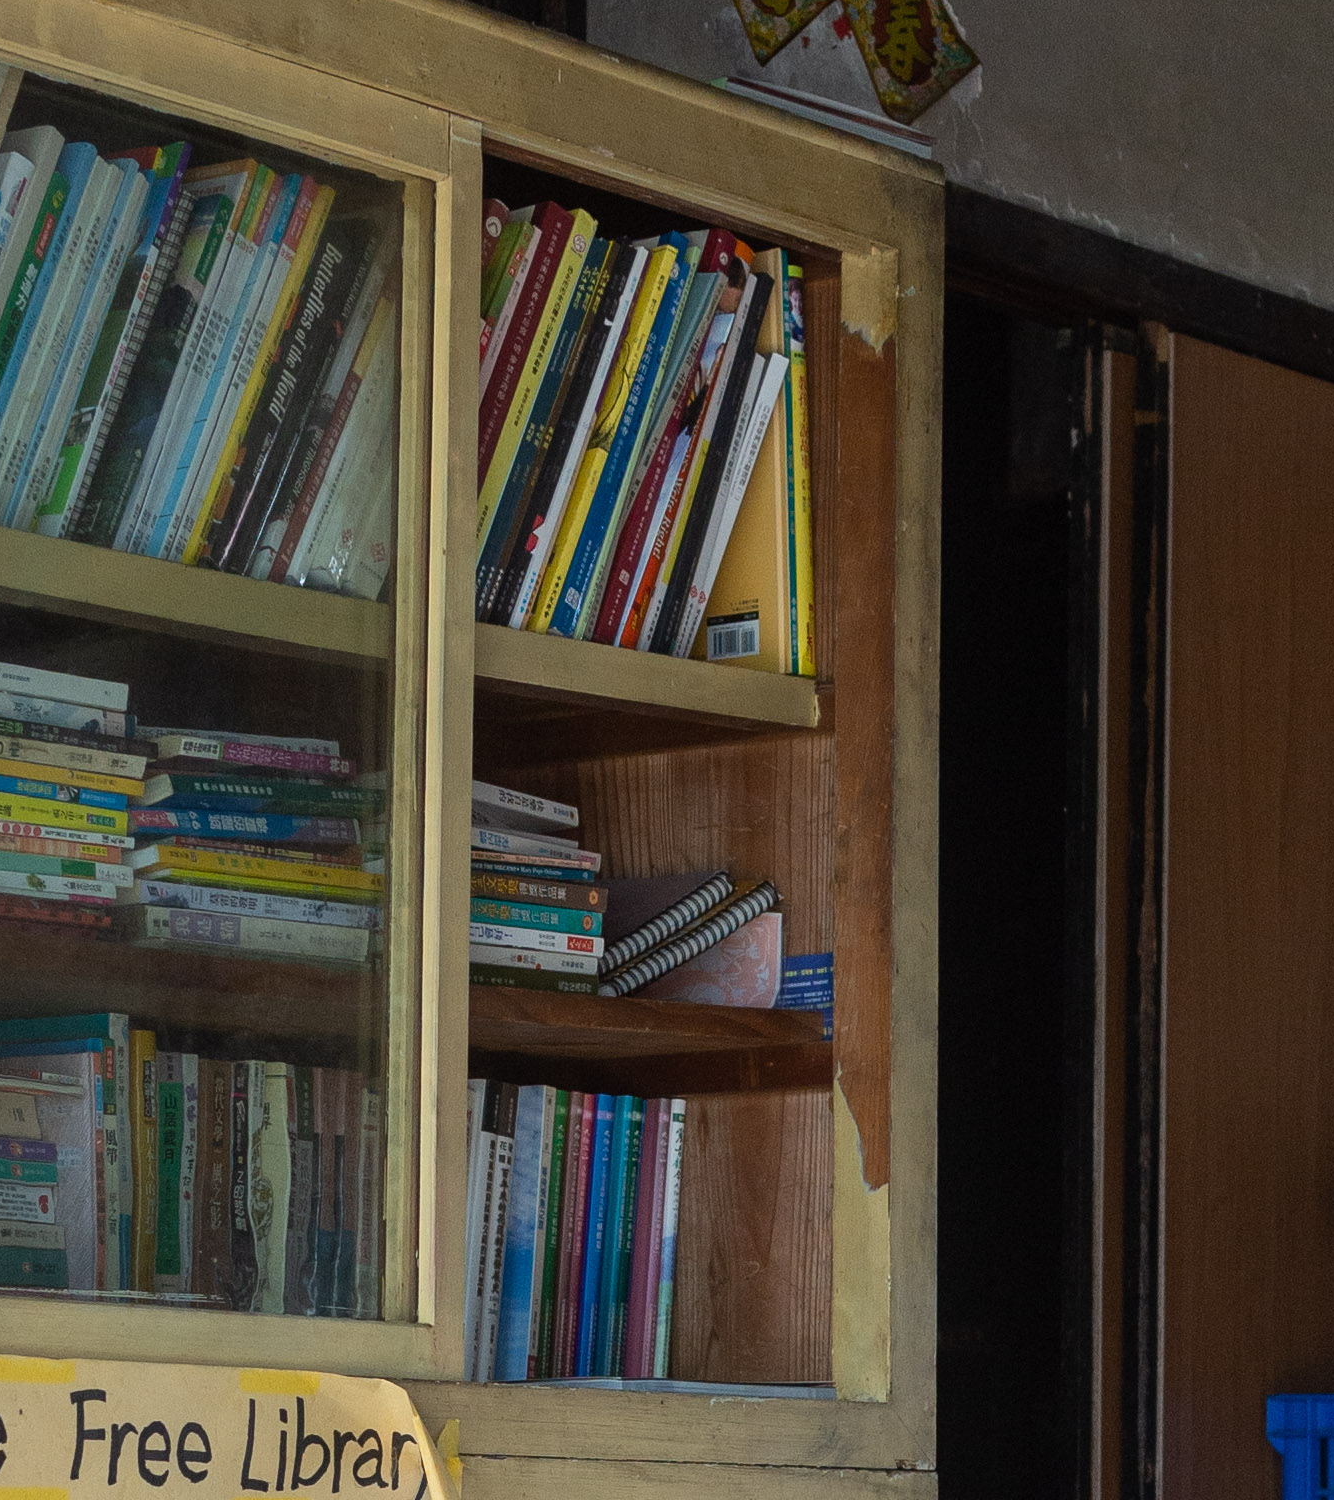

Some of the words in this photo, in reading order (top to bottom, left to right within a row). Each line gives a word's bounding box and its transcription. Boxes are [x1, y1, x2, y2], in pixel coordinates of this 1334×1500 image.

[301, 242, 343, 332] Butterflies
[286, 346, 303, 369] the
[294, 326, 309, 350] of
[269, 367, 298, 425] World
[175, 913, 237, 942] 我是貓
[163, 1093, 178, 1166] 山居歲月
[69, 1388, 213, 1489] Free
